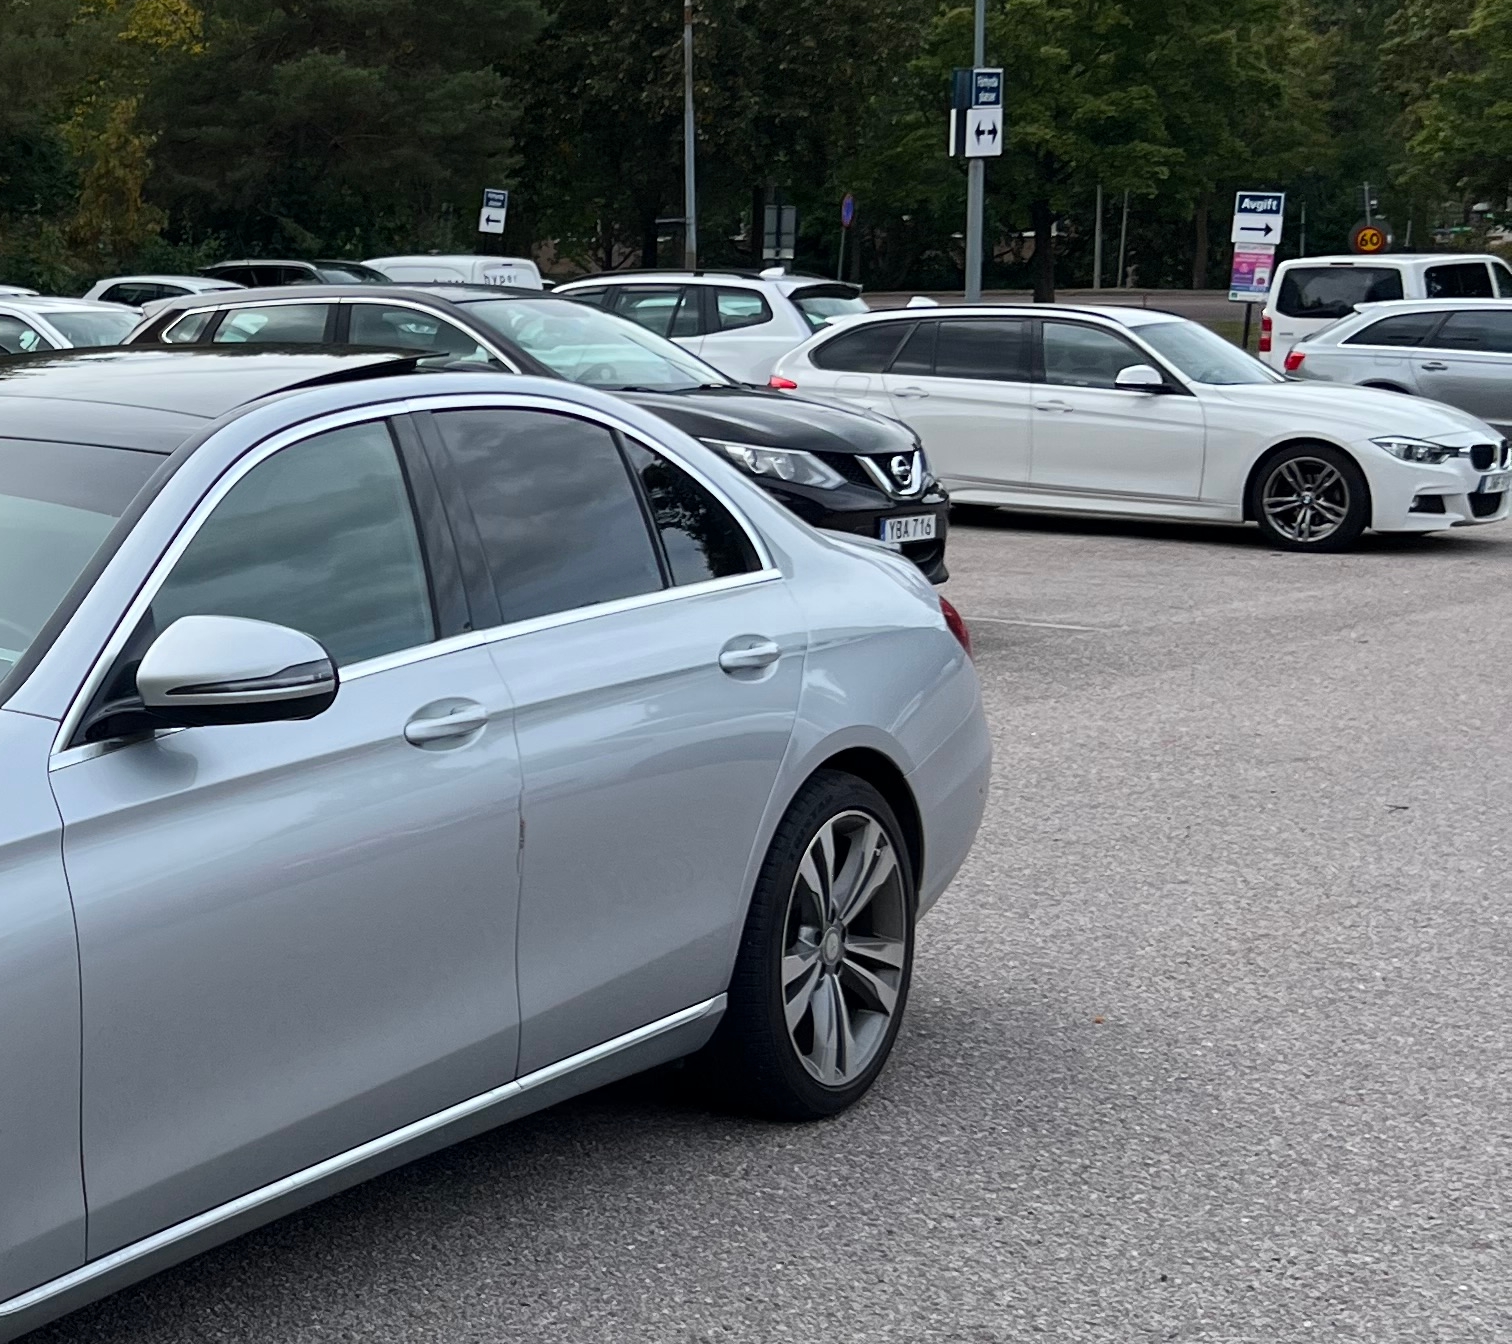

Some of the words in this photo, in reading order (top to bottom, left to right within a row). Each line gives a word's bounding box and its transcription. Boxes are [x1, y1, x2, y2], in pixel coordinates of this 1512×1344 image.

[1241, 198, 1278, 212] Avgift
[1360, 233, 1379, 246] 60
[889, 520, 910, 540] YBA
[913, 517, 932, 537] 716
